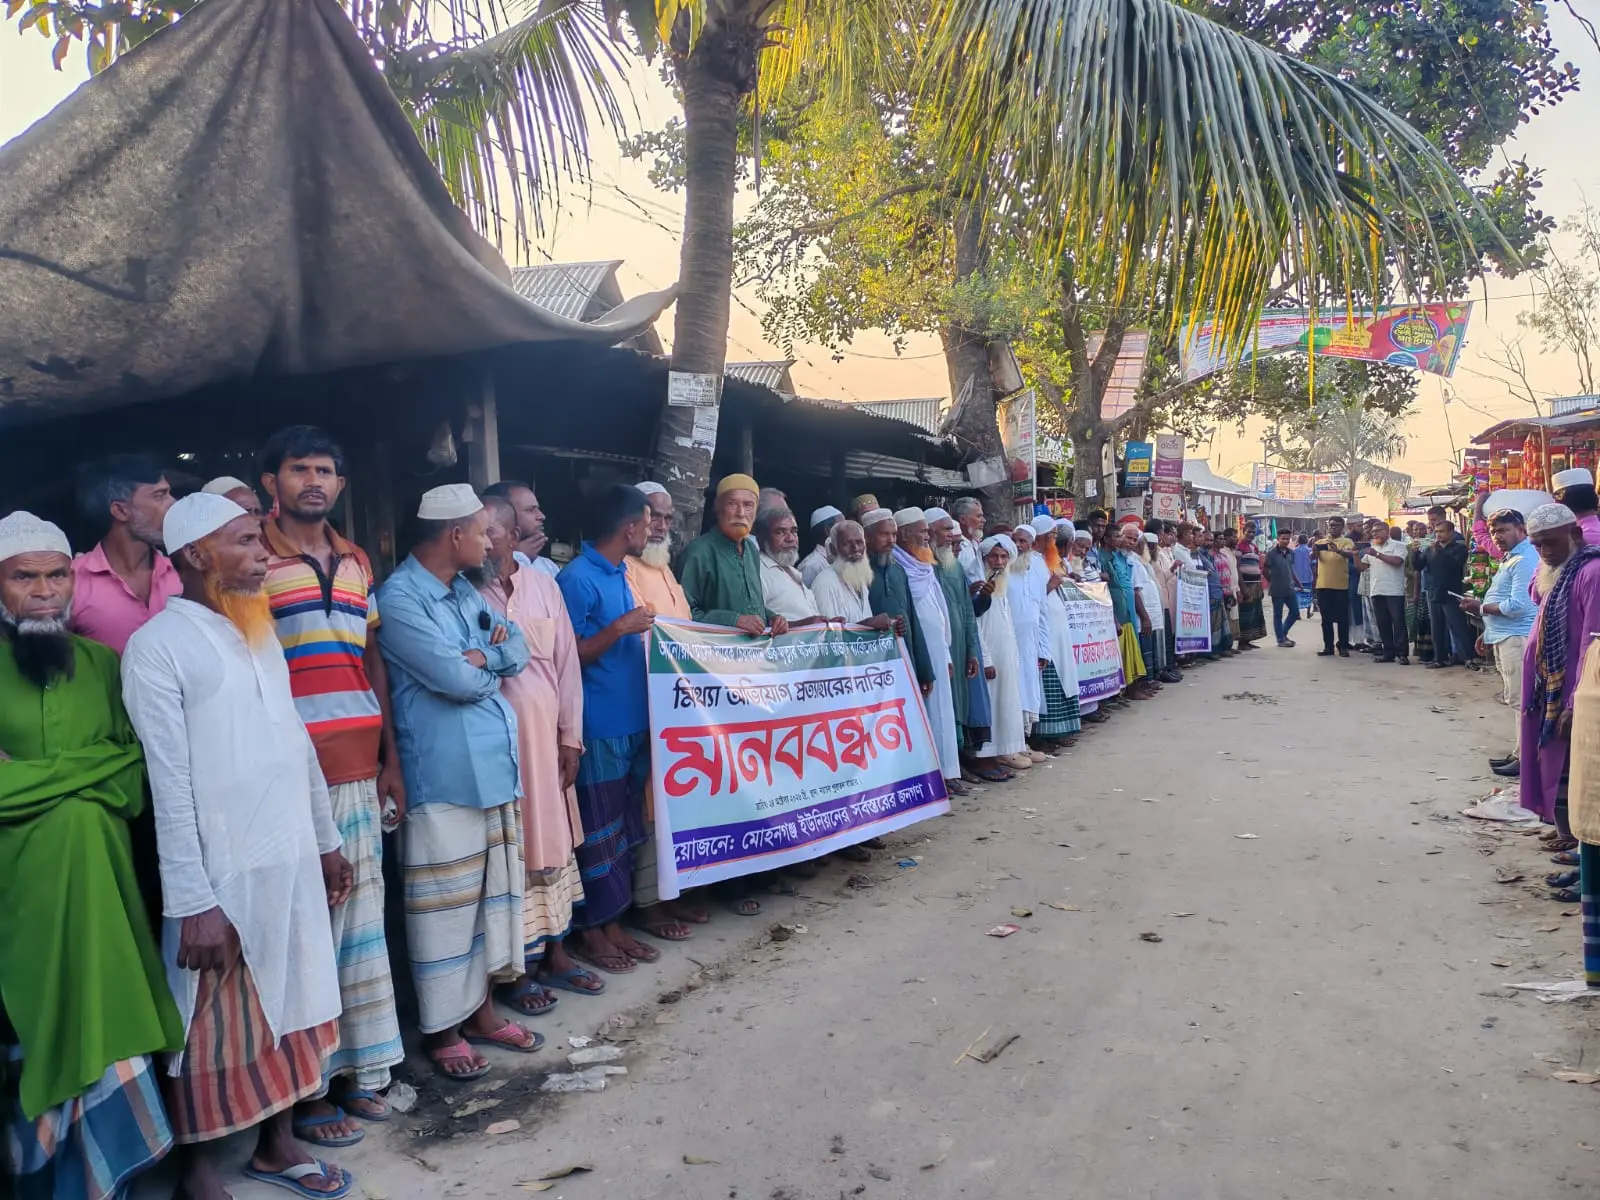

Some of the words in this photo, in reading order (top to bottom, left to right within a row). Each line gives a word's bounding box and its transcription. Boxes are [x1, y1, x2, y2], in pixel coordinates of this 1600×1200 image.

[672, 676, 722, 709] মিথ্যা
[724, 677, 792, 706] অভিযোগ
[793, 675, 852, 703] প্রত্যাহারের
[660, 697, 913, 798] মানববন্ধন
[742, 823, 798, 850] মোহনগঞ্জ
[798, 805, 849, 834] ইউনিয়নের
[852, 793, 897, 817] সর্বস্তরের
